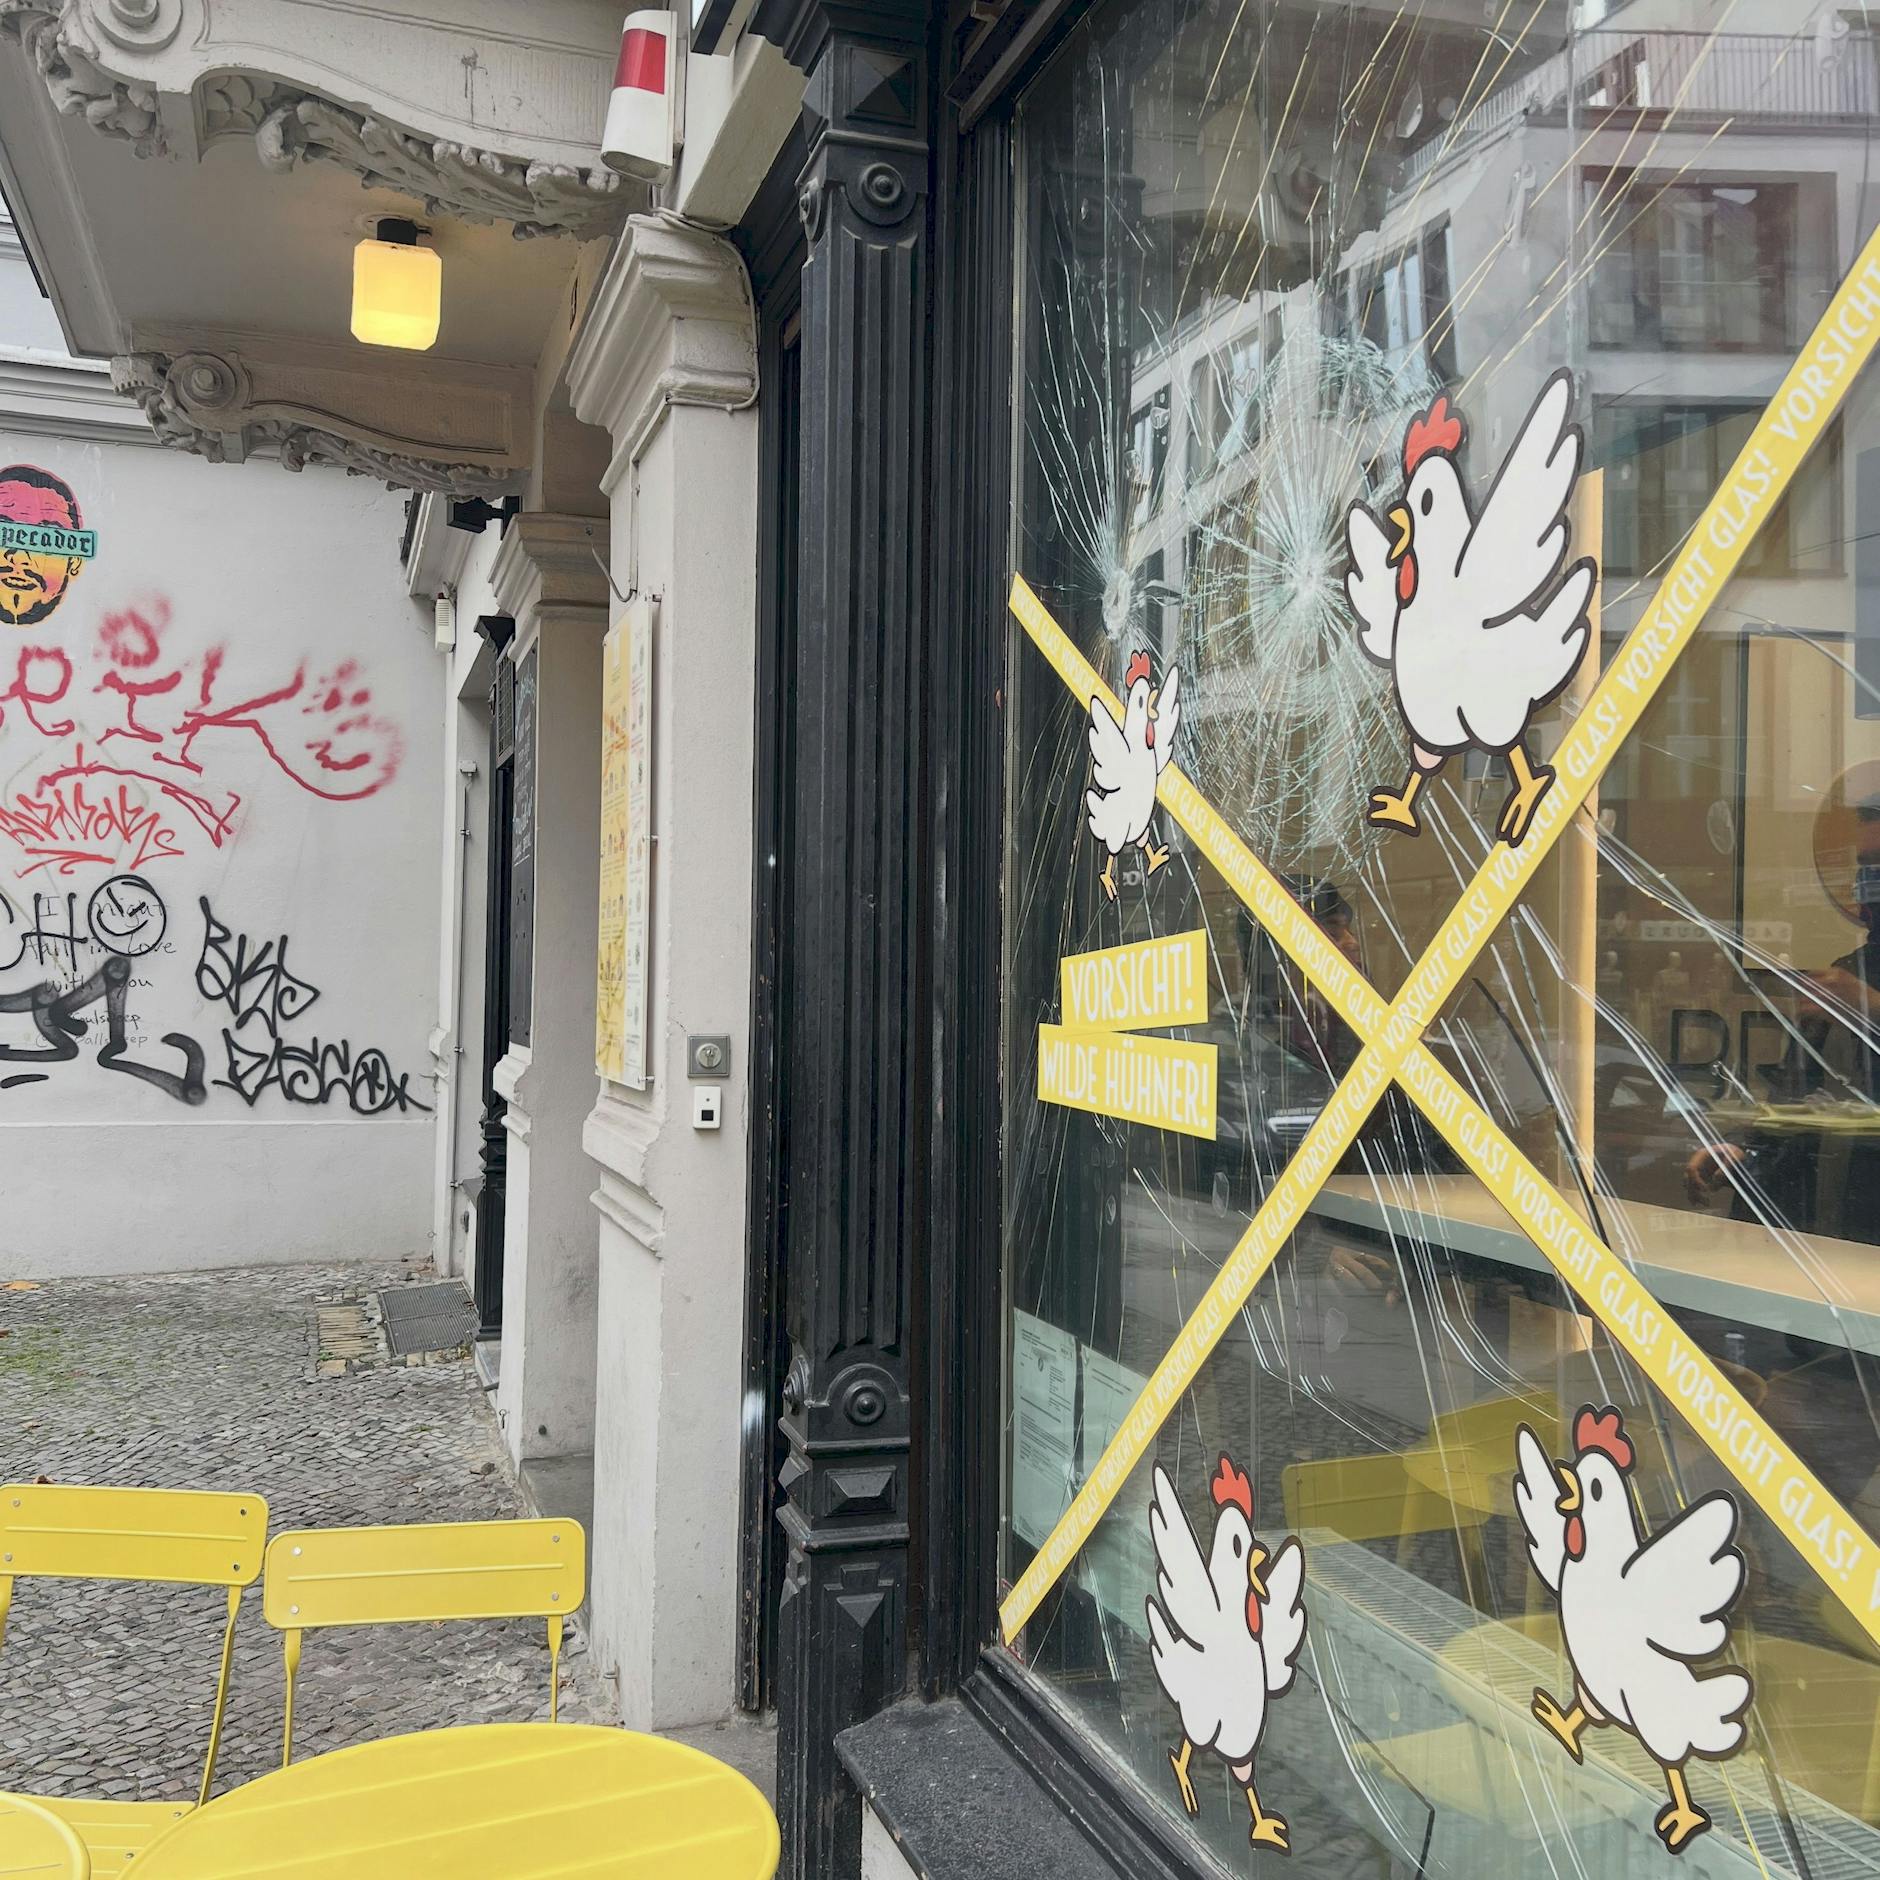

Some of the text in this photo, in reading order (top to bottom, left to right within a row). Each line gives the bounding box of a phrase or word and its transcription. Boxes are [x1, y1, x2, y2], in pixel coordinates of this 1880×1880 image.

[2, 526, 91, 553] pecador
[1068, 942, 1193, 1024] VORSICHT!
[1098, 1437, 1134, 1497] VORSICHT
[1131, 1399, 1157, 1450] GLAS!
[1155, 1341, 1194, 1408] VORSICHT
[1192, 1301, 1220, 1349] GLAS!
[1218, 1229, 1268, 1307] VORSICHT
[1263, 1185, 1298, 1240] GLAS!
[1293, 1103, 1352, 1190] VORSICHT
[1346, 1047, 1386, 1112] GLAS!
[1381, 949, 1449, 1053] VORSICHT
[1445, 890, 1493, 960] GLAS!
[1566, 694, 1623, 779] GLAS!
[1617, 544, 1715, 694] VORSICHT
[1708, 448, 1779, 549] GLAS!
[1042, 1038, 1209, 1129] WILDE HÜHNER!
[1179, 788, 1209, 838] GLAS!
[1208, 821, 1258, 894] VORSICHT
[1255, 879, 1289, 932] GLAS!
[1289, 915, 1350, 998] VORSICHT
[1401, 1050, 1463, 1128] RSICHT
[1457, 1110, 1509, 1183] GLAS!
[1510, 1164, 1602, 1284] VORSICHT
[1599, 1270, 1662, 1357] GLAS!
[1664, 1338, 1782, 1487] VORSICHT
[1779, 1475, 1863, 1582] GLAS!
